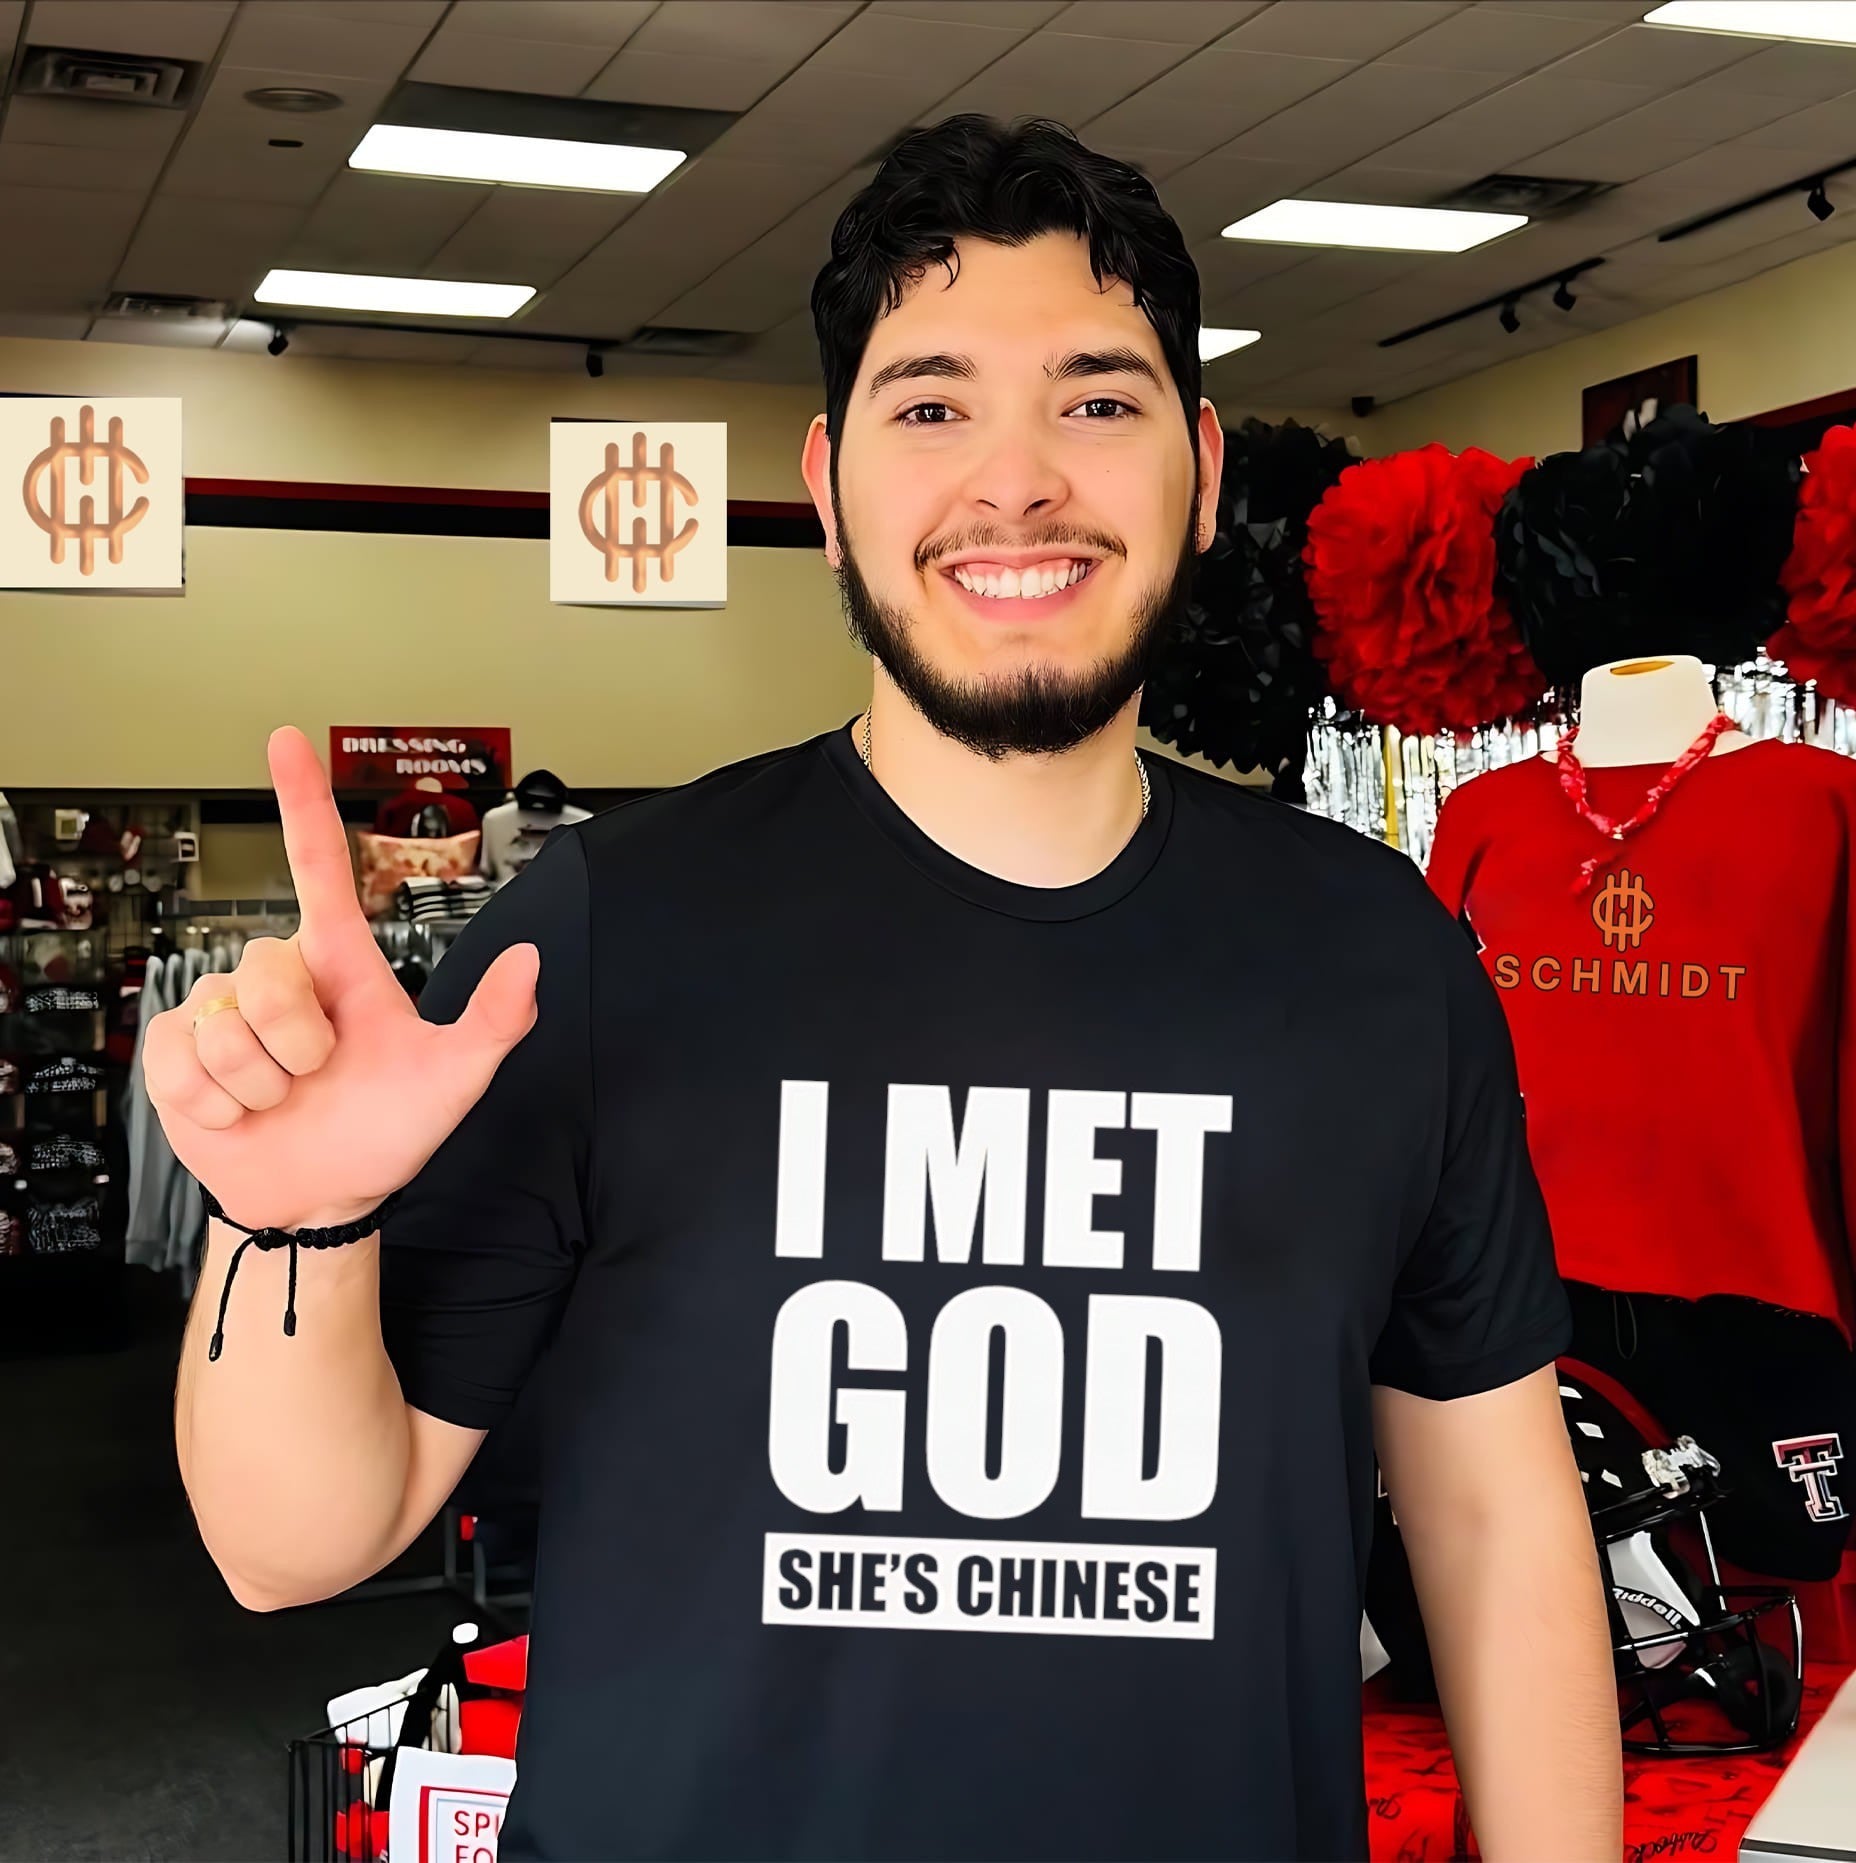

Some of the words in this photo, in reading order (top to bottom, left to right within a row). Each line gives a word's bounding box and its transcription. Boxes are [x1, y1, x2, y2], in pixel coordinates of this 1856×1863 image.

[342, 737, 467, 753] DRESSING
[396, 758, 487, 775] ROOMS
[1494, 953, 1747, 1000] SCHMIDT
[776, 1080, 828, 1258] I
[882, 1084, 1233, 1271] MET
[769, 1280, 1221, 1520] GOD
[779, 1549, 938, 1615] SHE’S
[957, 1555, 1201, 1623] CHINESE
